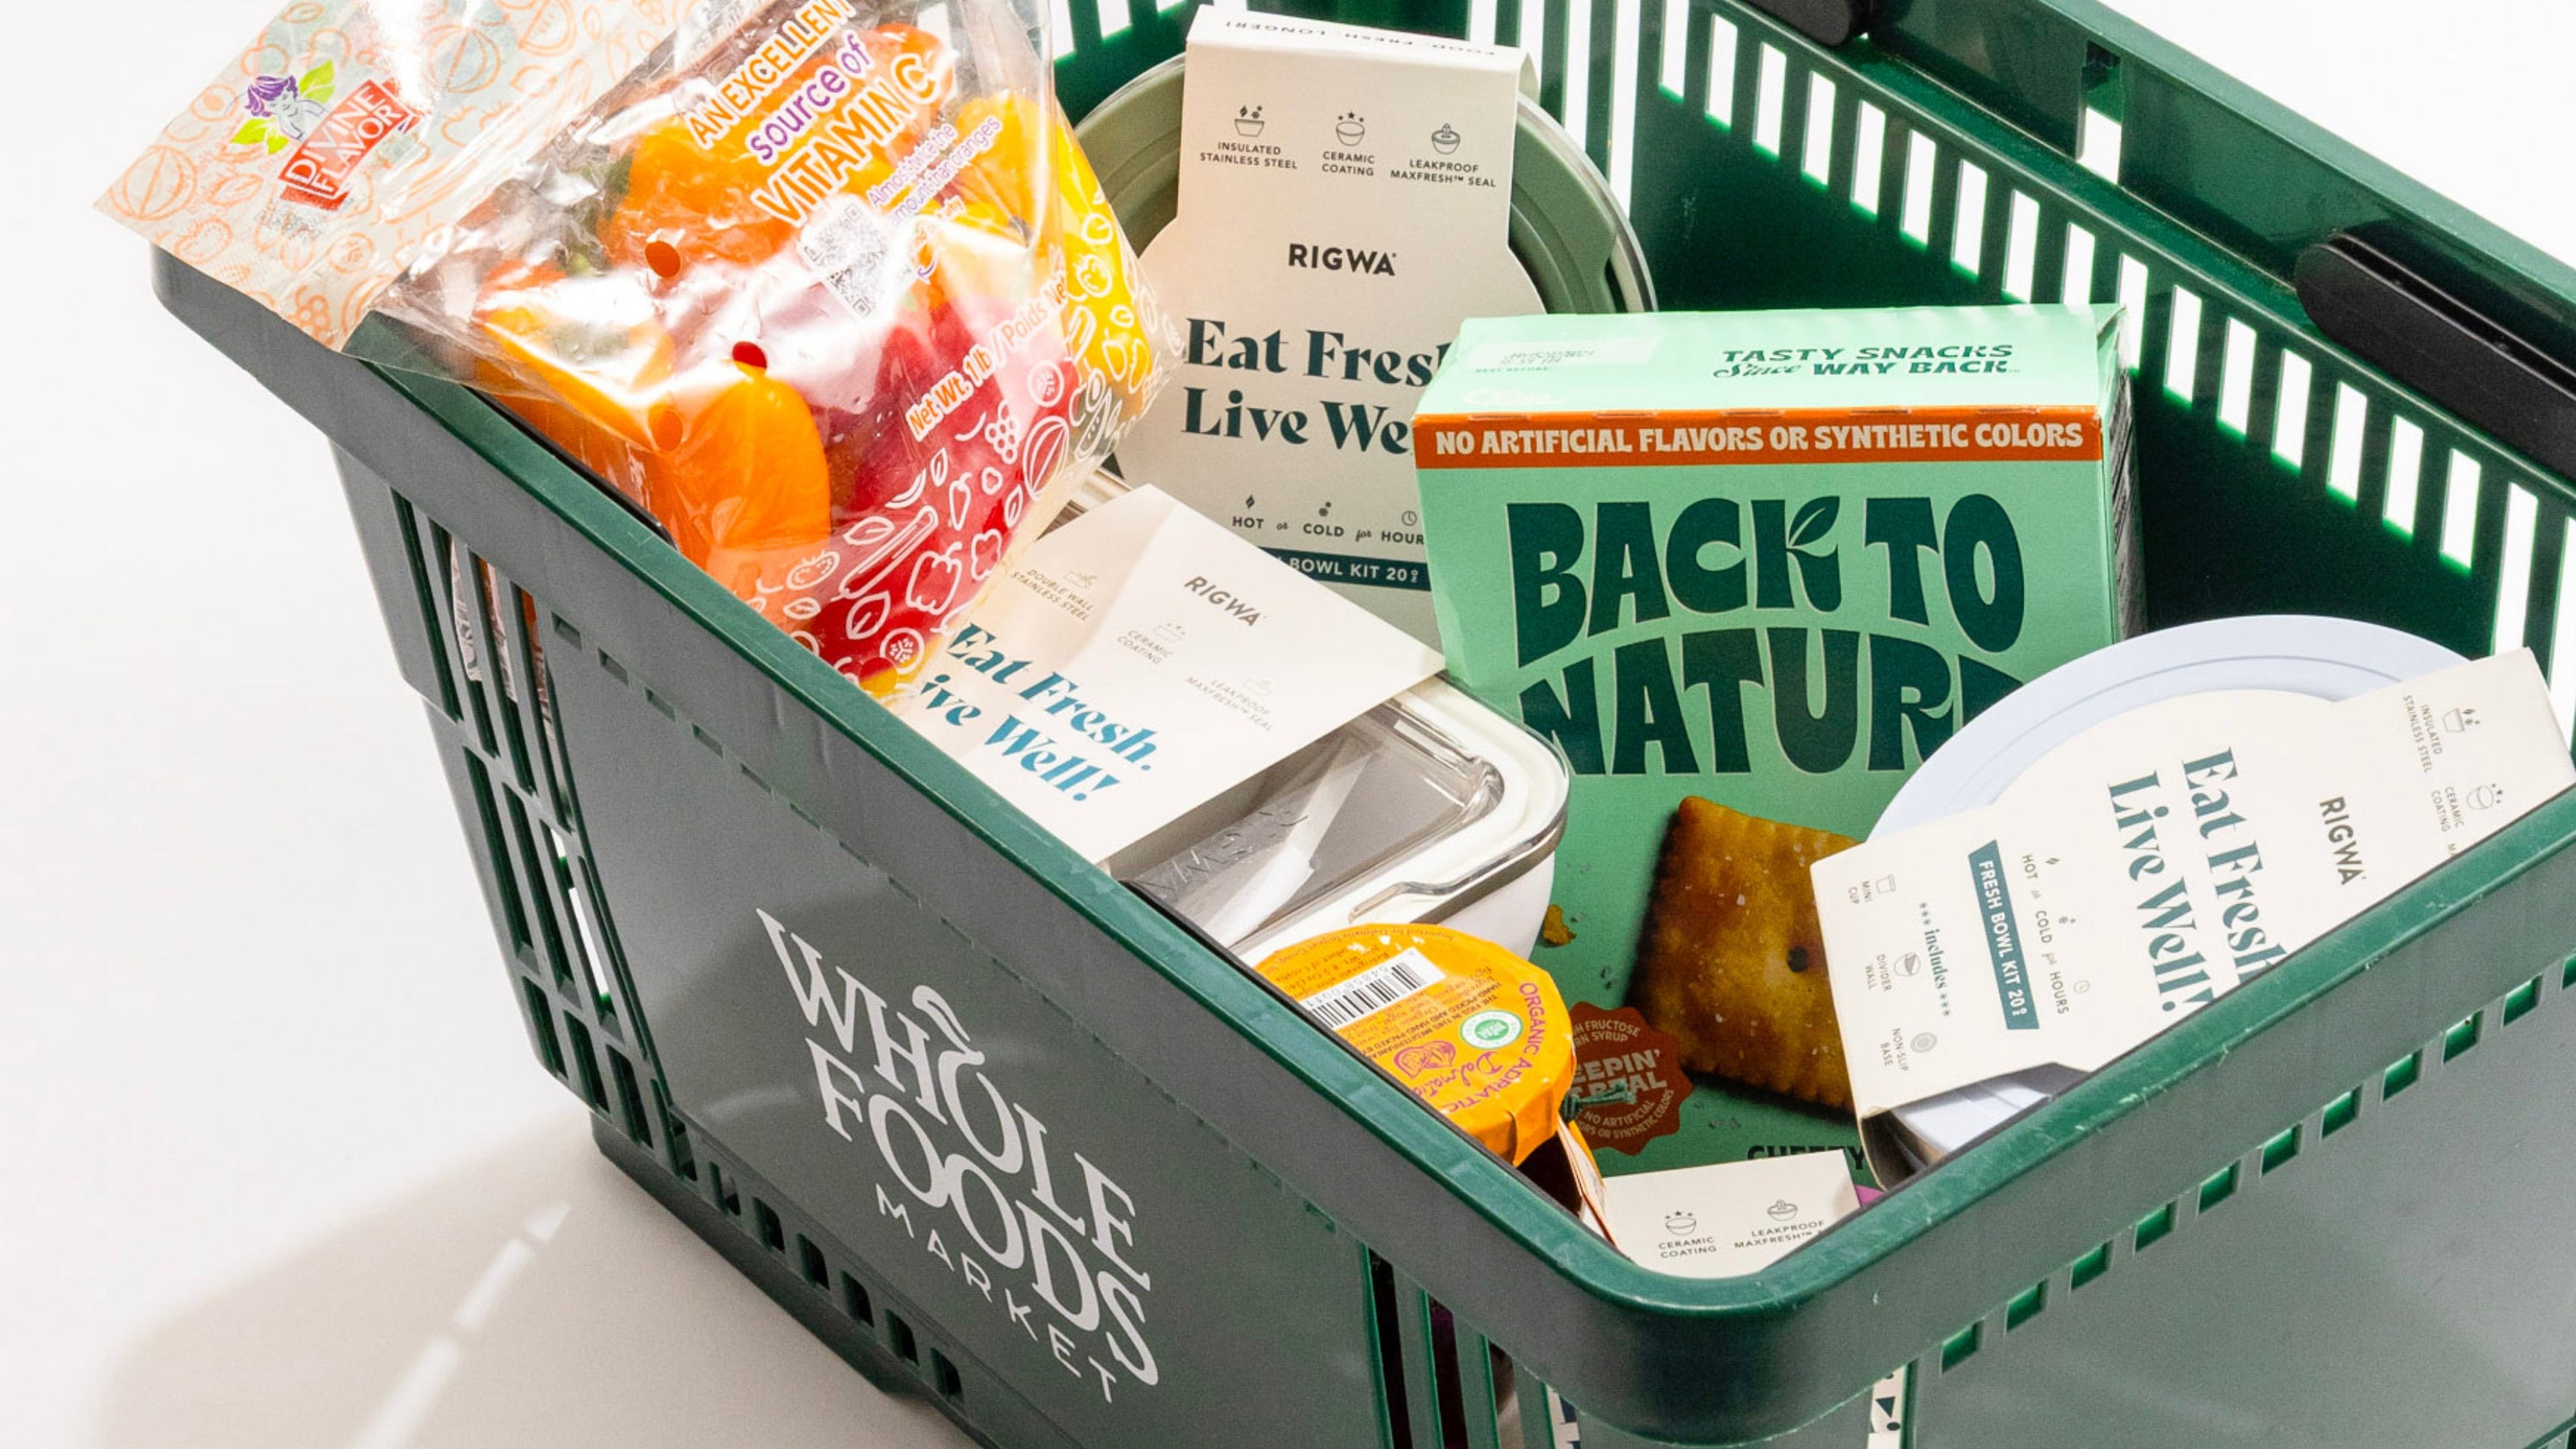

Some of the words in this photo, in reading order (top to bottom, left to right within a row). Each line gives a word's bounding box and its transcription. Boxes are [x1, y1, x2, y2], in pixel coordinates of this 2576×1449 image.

[750, 68, 845, 161] source
[841, 33, 871, 75] of
[288, 89, 380, 186] DIVINE
[690, 99, 724, 144] AN
[754, 82, 904, 223] VITAMIN
[895, 57, 935, 100] C
[312, 103, 400, 195] FLAVOR
[866, 161, 915, 208] Almost
[907, 140, 939, 172] twice
[929, 121, 957, 149] the
[1200, 153, 1260, 167] STAINLESS
[1265, 156, 1297, 169] STEEL
[1218, 142, 1281, 155] INSULATED
[1321, 163, 1374, 176] COATING
[1322, 151, 1375, 164] CERAMIC
[1409, 159, 1479, 173] LEAKPROOF
[886, 181, 935, 227] amount
[926, 159, 956, 189] than
[946, 114, 1005, 170] oranges
[1468, 177, 1496, 188] SEAL
[1289, 244, 1396, 276] RIGWA
[908, 397, 938, 434] Net
[933, 371, 969, 409] Wt.
[999, 298, 1049, 347] Poids
[1184, 318, 1289, 373] Eat
[1722, 349, 1844, 361] TASTY
[1856, 345, 2013, 360] SNACKS
[1713, 363, 1801, 378] Since
[1814, 362, 1896, 375] WAY
[1182, 387, 1309, 445] Live
[1321, 401, 1412, 455] We
[1436, 430, 1475, 456] NO
[1481, 428, 1632, 454] ARTIFICIAL
[1639, 426, 1763, 453] FLAVORS
[1769, 426, 1809, 451] OR
[1814, 424, 1968, 452] SYNTHETIC
[1974, 422, 2084, 449] COLORS
[1232, 516, 1264, 530] HOT
[1276, 521, 1289, 530] or
[1303, 523, 1344, 537] COLD
[1355, 528, 1372, 542] for
[1382, 530, 1425, 545] HOUR
[1026, 567, 1067, 595] DOUBLE
[1066, 592, 1093, 611] WALL
[1290, 557, 1342, 576] BOWL
[1352, 563, 1380, 579] KIT
[1507, 495, 1843, 667] BACK
[1864, 494, 2025, 652] TO
[1009, 569, 1060, 603] STAINLESS
[1060, 601, 1091, 621] STEEL
[1184, 576, 1265, 627] RIGWA
[1115, 634, 1163, 665] COATING
[1126, 628, 1174, 659] CERAMIC
[945, 622, 1032, 685] Eat
[1019, 671, 1163, 772] Fresh.
[1209, 677, 1271, 718] LEAKPROOF
[921, 673, 982, 727] ive
[984, 715, 1120, 802] Well!
[1248, 713, 1274, 731] SEAL
[2403, 694, 2424, 743] STAINLESS
[2418, 745, 2433, 773] STEEL
[2421, 704, 2443, 755] INSULATED
[2181, 745, 2247, 841] Eat
[2431, 790, 2451, 833] COATING
[2445, 786, 2464, 828] CERAMIC
[2106, 770, 2170, 882] Live
[2318, 796, 2367, 886] RIGWA
[1848, 887, 1860, 905] CUP
[1862, 881, 1874, 902] MINI
[1978, 860, 2002, 909] FRESH
[1990, 912, 2014, 958] BOWL
[2002, 959, 2020, 985] KIT
[2021, 854, 2038, 880] HOT
[2035, 910, 2052, 944] COLD
[2050, 971, 2069, 1015] HOURS
[1865, 963, 1878, 991] WALL
[1876, 954, 1893, 992] DIVIDER
[1924, 929, 1948, 989] includes
[1460, 1001, 1481, 1016] FIGS
[1480, 992, 1498, 1005] THE
[1519, 982, 1546, 1057] ORGANIC
[1585, 1020, 1642, 1038] FRUCTOSE
[1593, 1031, 1629, 1042] SYRUP
[1893, 1028, 1909, 1072] NON-SLIP
[1573, 1048, 1661, 1085] EEPIN'
[1880, 1042, 1893, 1067] BASE
[756, 907, 1151, 1292] WHOLE
[1449, 1058, 1534, 1114] ADRIATIC
[1583, 1112, 1601, 1125] NO
[1602, 1100, 1656, 1127] ARTIFICIAL
[1598, 1127, 1612, 1139] OR
[1612, 1115, 1658, 1139] SYNTHETIC
[1653, 1088, 1674, 1119] COLORS
[805, 1037, 1159, 1386] FOODS
[1751, 1220, 1825, 1237] LEAKPROOF
[1658, 1236, 1715, 1250] CERAMIC
[1660, 1246, 1717, 1258] COATING
[875, 1183, 1116, 1404] MARKET
